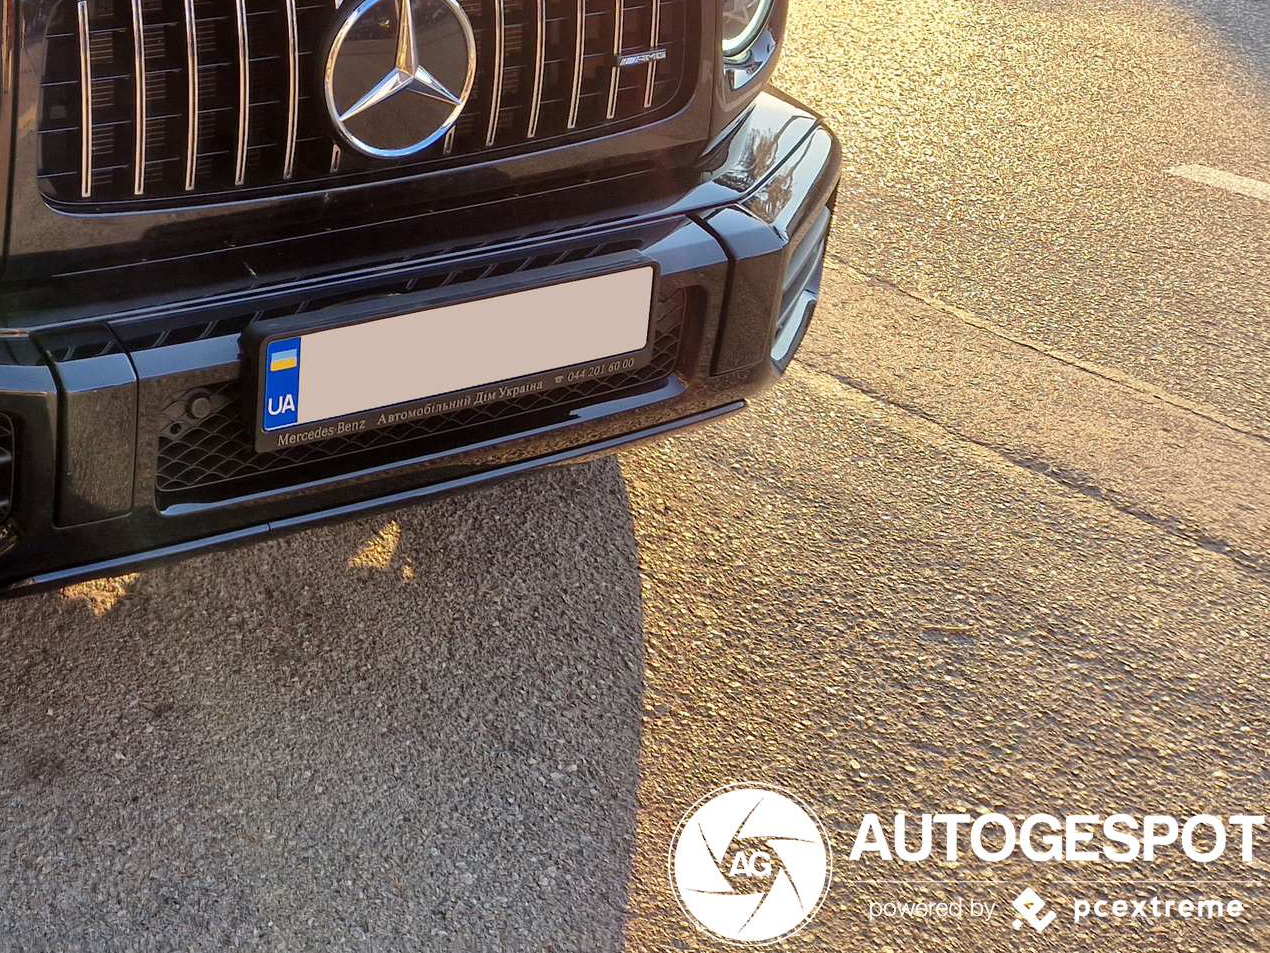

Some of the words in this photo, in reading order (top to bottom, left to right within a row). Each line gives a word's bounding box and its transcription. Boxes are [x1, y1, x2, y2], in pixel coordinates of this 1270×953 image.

[267, 394, 296, 416] UA
[277, 419, 366, 446] Mercedes-Benz
[376, 395, 471, 426] Автомобільний
[473, 391, 496, 405] Дім
[498, 380, 543, 398] Україна
[567, 370, 586, 382] 044
[588, 364, 604, 376] 201
[608, 360, 620, 372] 60
[622, 357, 634, 369] 00
